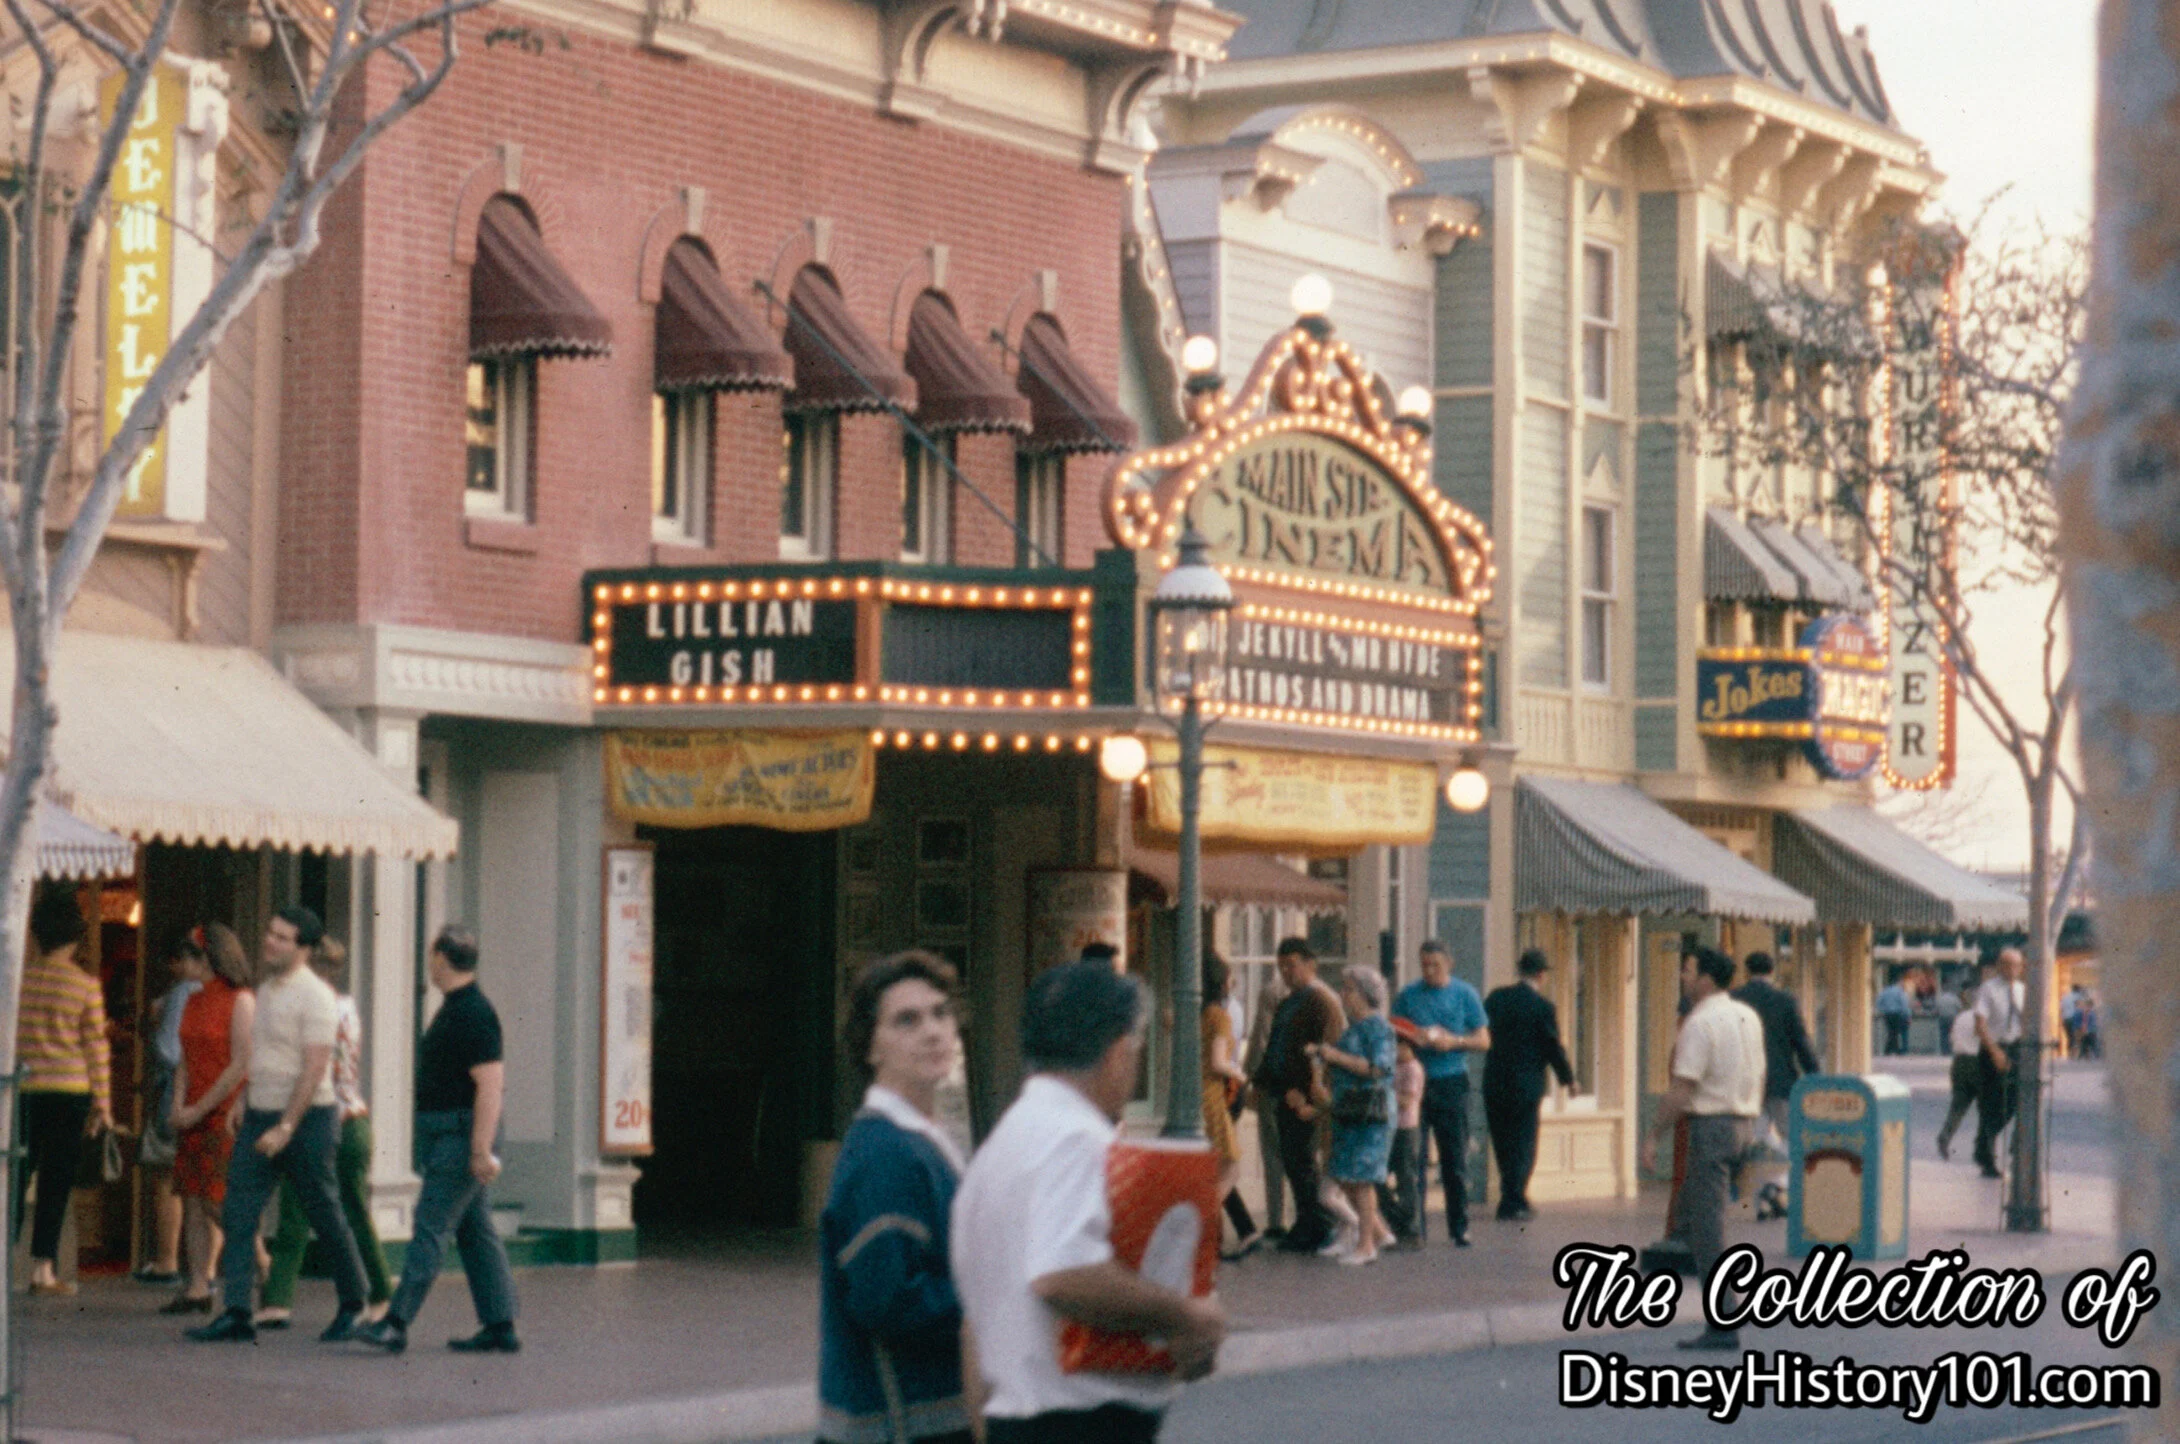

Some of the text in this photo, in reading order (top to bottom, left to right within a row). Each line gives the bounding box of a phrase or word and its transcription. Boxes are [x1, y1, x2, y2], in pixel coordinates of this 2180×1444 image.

[1237, 447, 1318, 517] MAIN
[1186, 466, 1447, 589] CINEMA
[646, 598, 813, 637] LILLIAN
[671, 649, 774, 685] GISH
[1239, 620, 1323, 664] JEKYLL
[1388, 639, 1440, 678] HYDE
[1311, 677, 1353, 715] AND
[1361, 683, 1429, 721] DRAMA
[1702, 665, 1803, 720] Jokes
